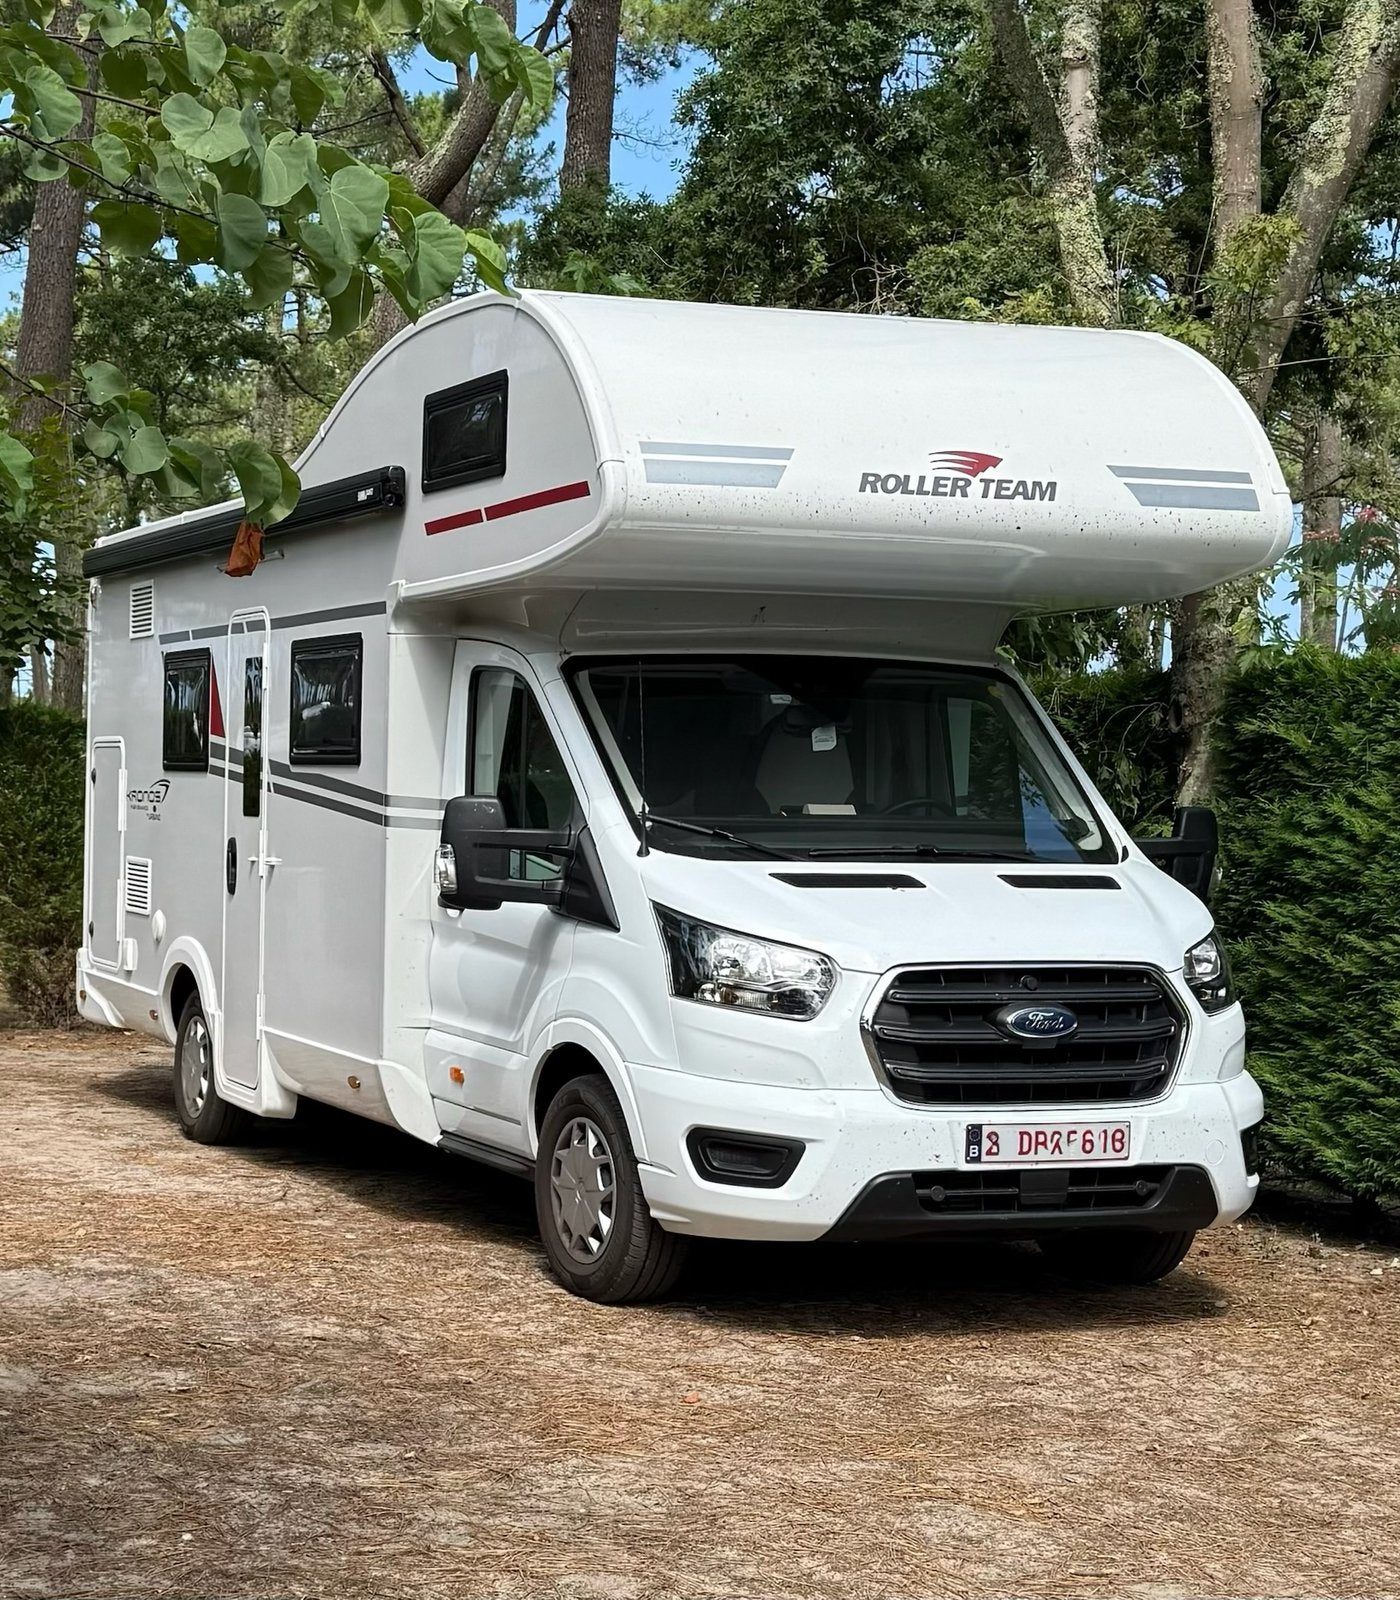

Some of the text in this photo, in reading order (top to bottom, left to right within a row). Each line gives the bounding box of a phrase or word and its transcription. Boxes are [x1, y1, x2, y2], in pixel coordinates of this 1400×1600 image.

[858, 472, 1058, 501] ROLLER TEAM
[1024, 1011, 1064, 1030] Ford
[969, 1145, 979, 1158] B
